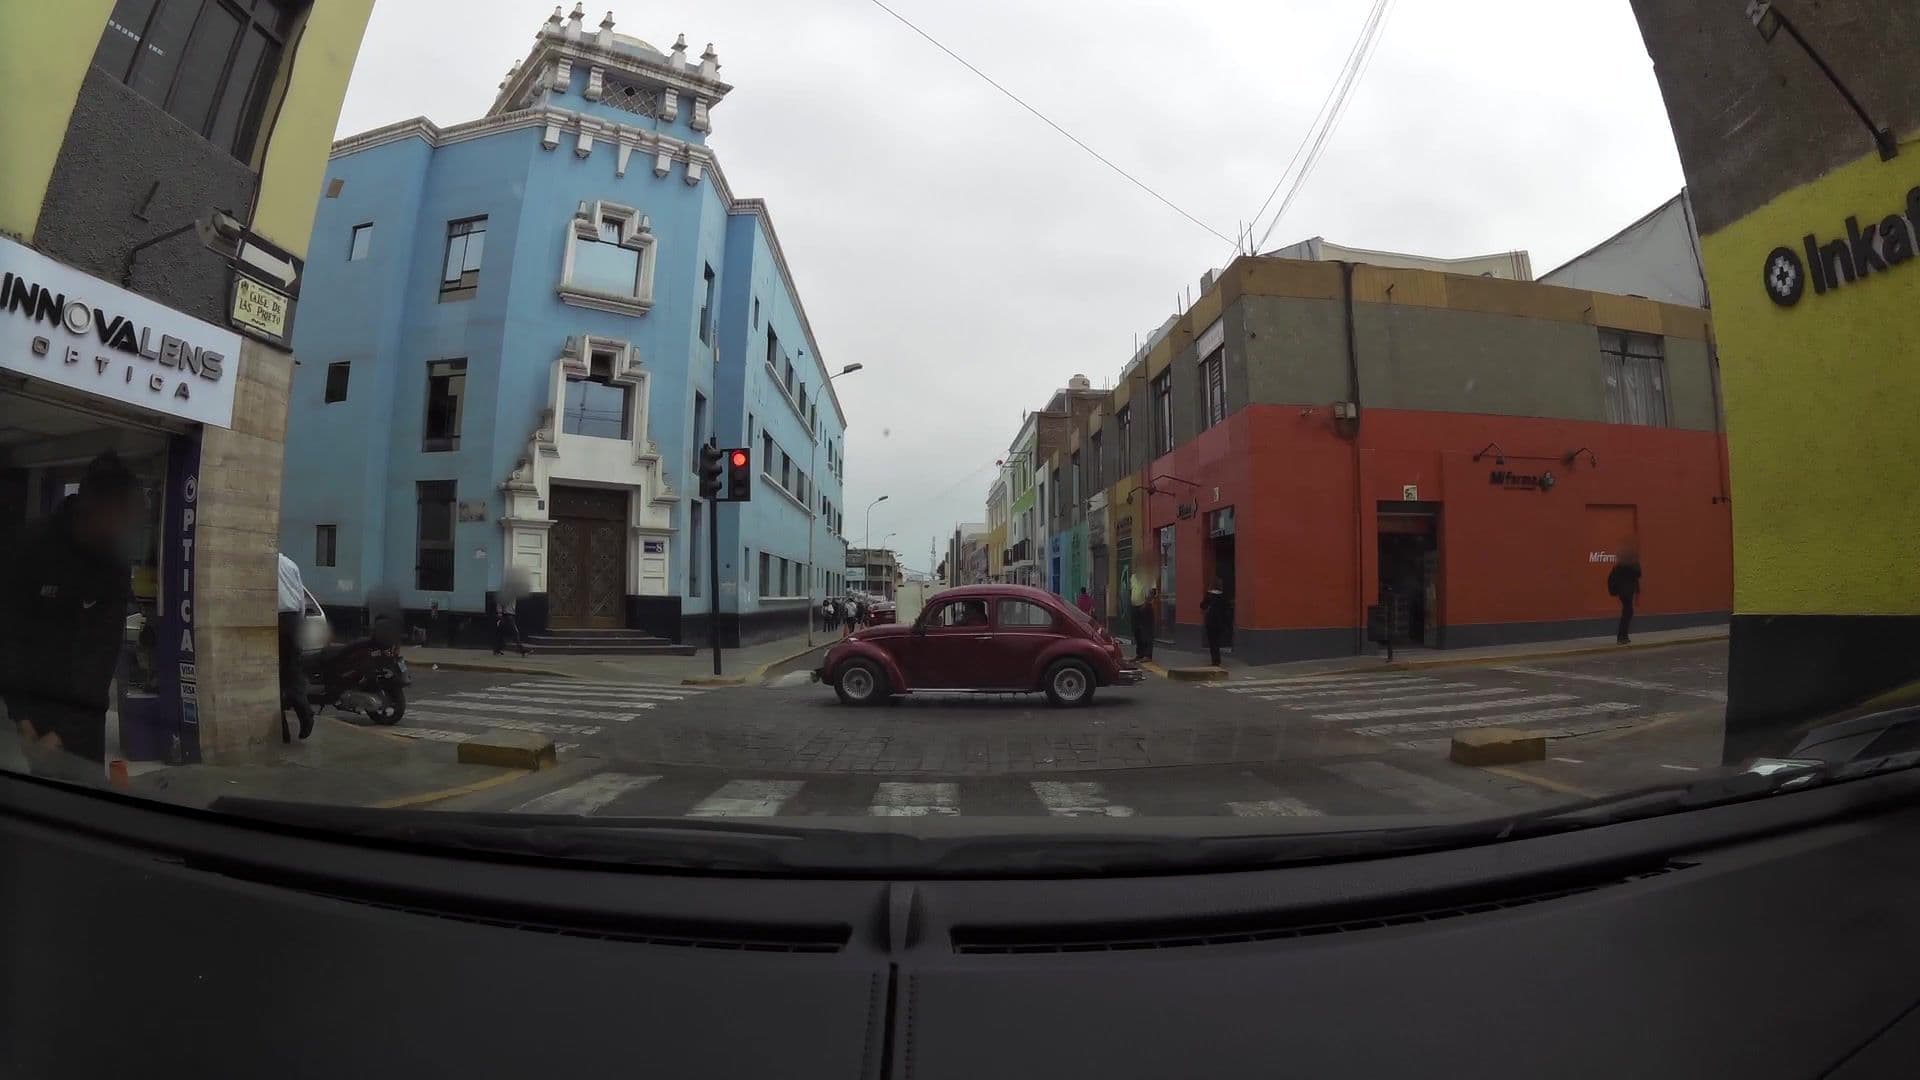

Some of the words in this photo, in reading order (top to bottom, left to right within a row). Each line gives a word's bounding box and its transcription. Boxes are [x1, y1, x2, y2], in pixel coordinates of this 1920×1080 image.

[0, 272, 224, 380] INNOVALENS
[32, 335, 191, 400] OPTICA
[180, 474, 197, 653] OPTICA
